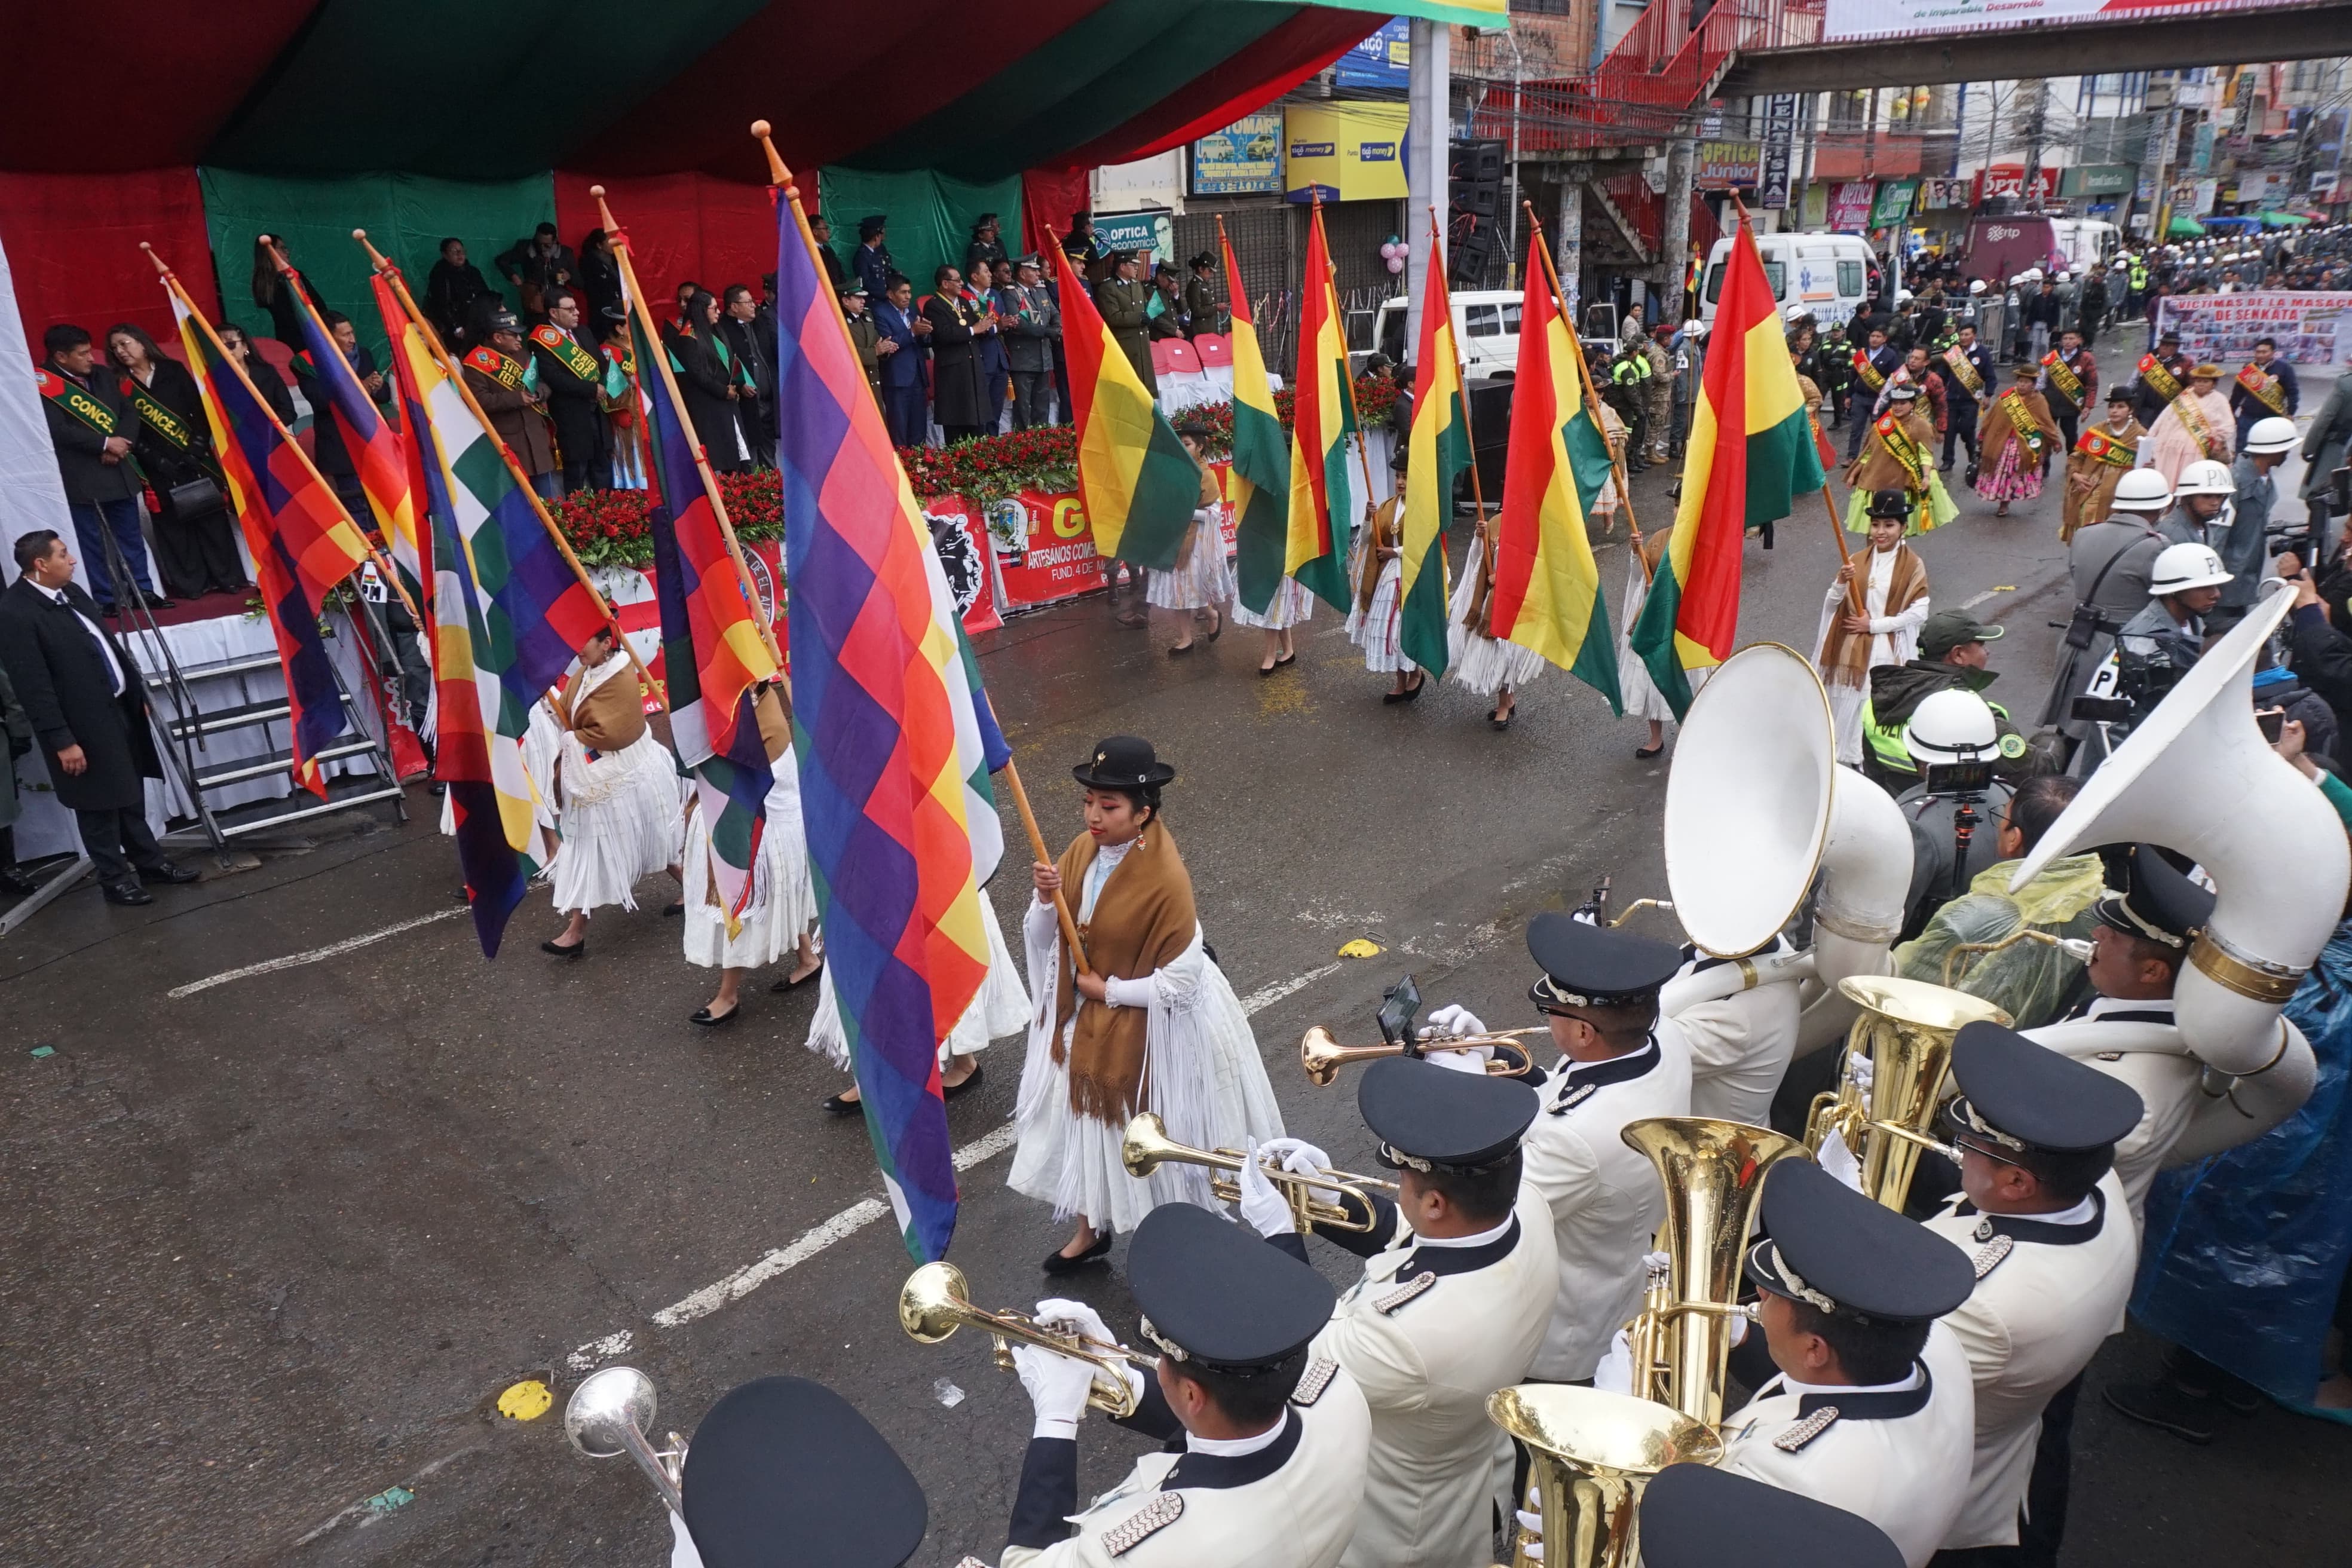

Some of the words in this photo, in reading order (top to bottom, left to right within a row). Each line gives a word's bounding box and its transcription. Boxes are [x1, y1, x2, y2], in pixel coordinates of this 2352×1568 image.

[1372, 147, 1387, 157] money
[1704, 142, 1760, 163] OPTICA
[1765, 94, 1793, 195] DENTISTA
[1701, 164, 1758, 178] Júnior
[1110, 226, 1148, 240] OPTICA
[1111, 238, 1156, 250] economica
[2248, 298, 2263, 307] DE
[2269, 298, 2286, 307] LA
[2216, 310, 2231, 321] DE
[70, 394, 114, 434] CONCE
[2206, 469, 2234, 487] PM
[750, 561, 764, 575] DE
[758, 576, 770, 592] EL
[1052, 565, 1074, 581] FUND.
[1076, 564, 1080, 575] 4
[1082, 562, 1094, 573] DE
